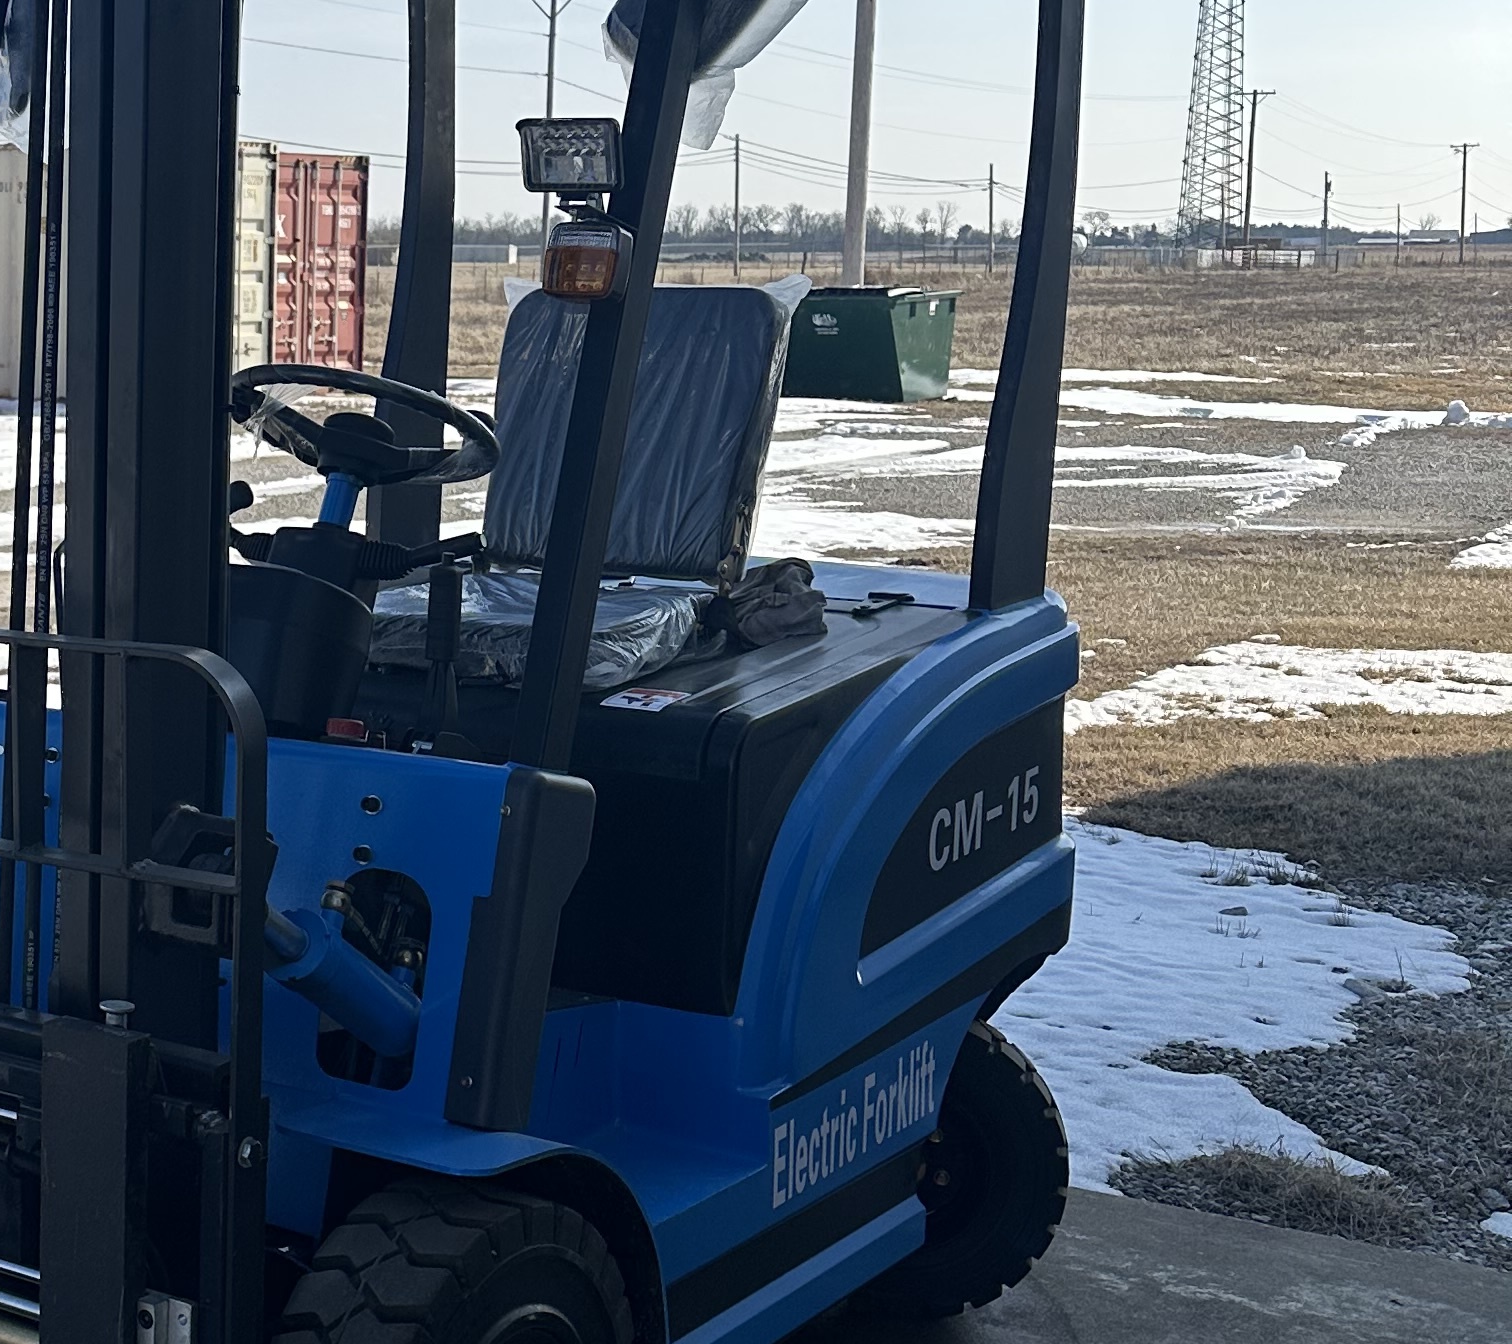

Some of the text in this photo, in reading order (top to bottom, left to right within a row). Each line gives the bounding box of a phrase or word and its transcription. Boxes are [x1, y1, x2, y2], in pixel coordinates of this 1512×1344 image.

[928, 765, 1040, 872] CM-15
[772, 1040, 937, 1210] Electric Forklift
